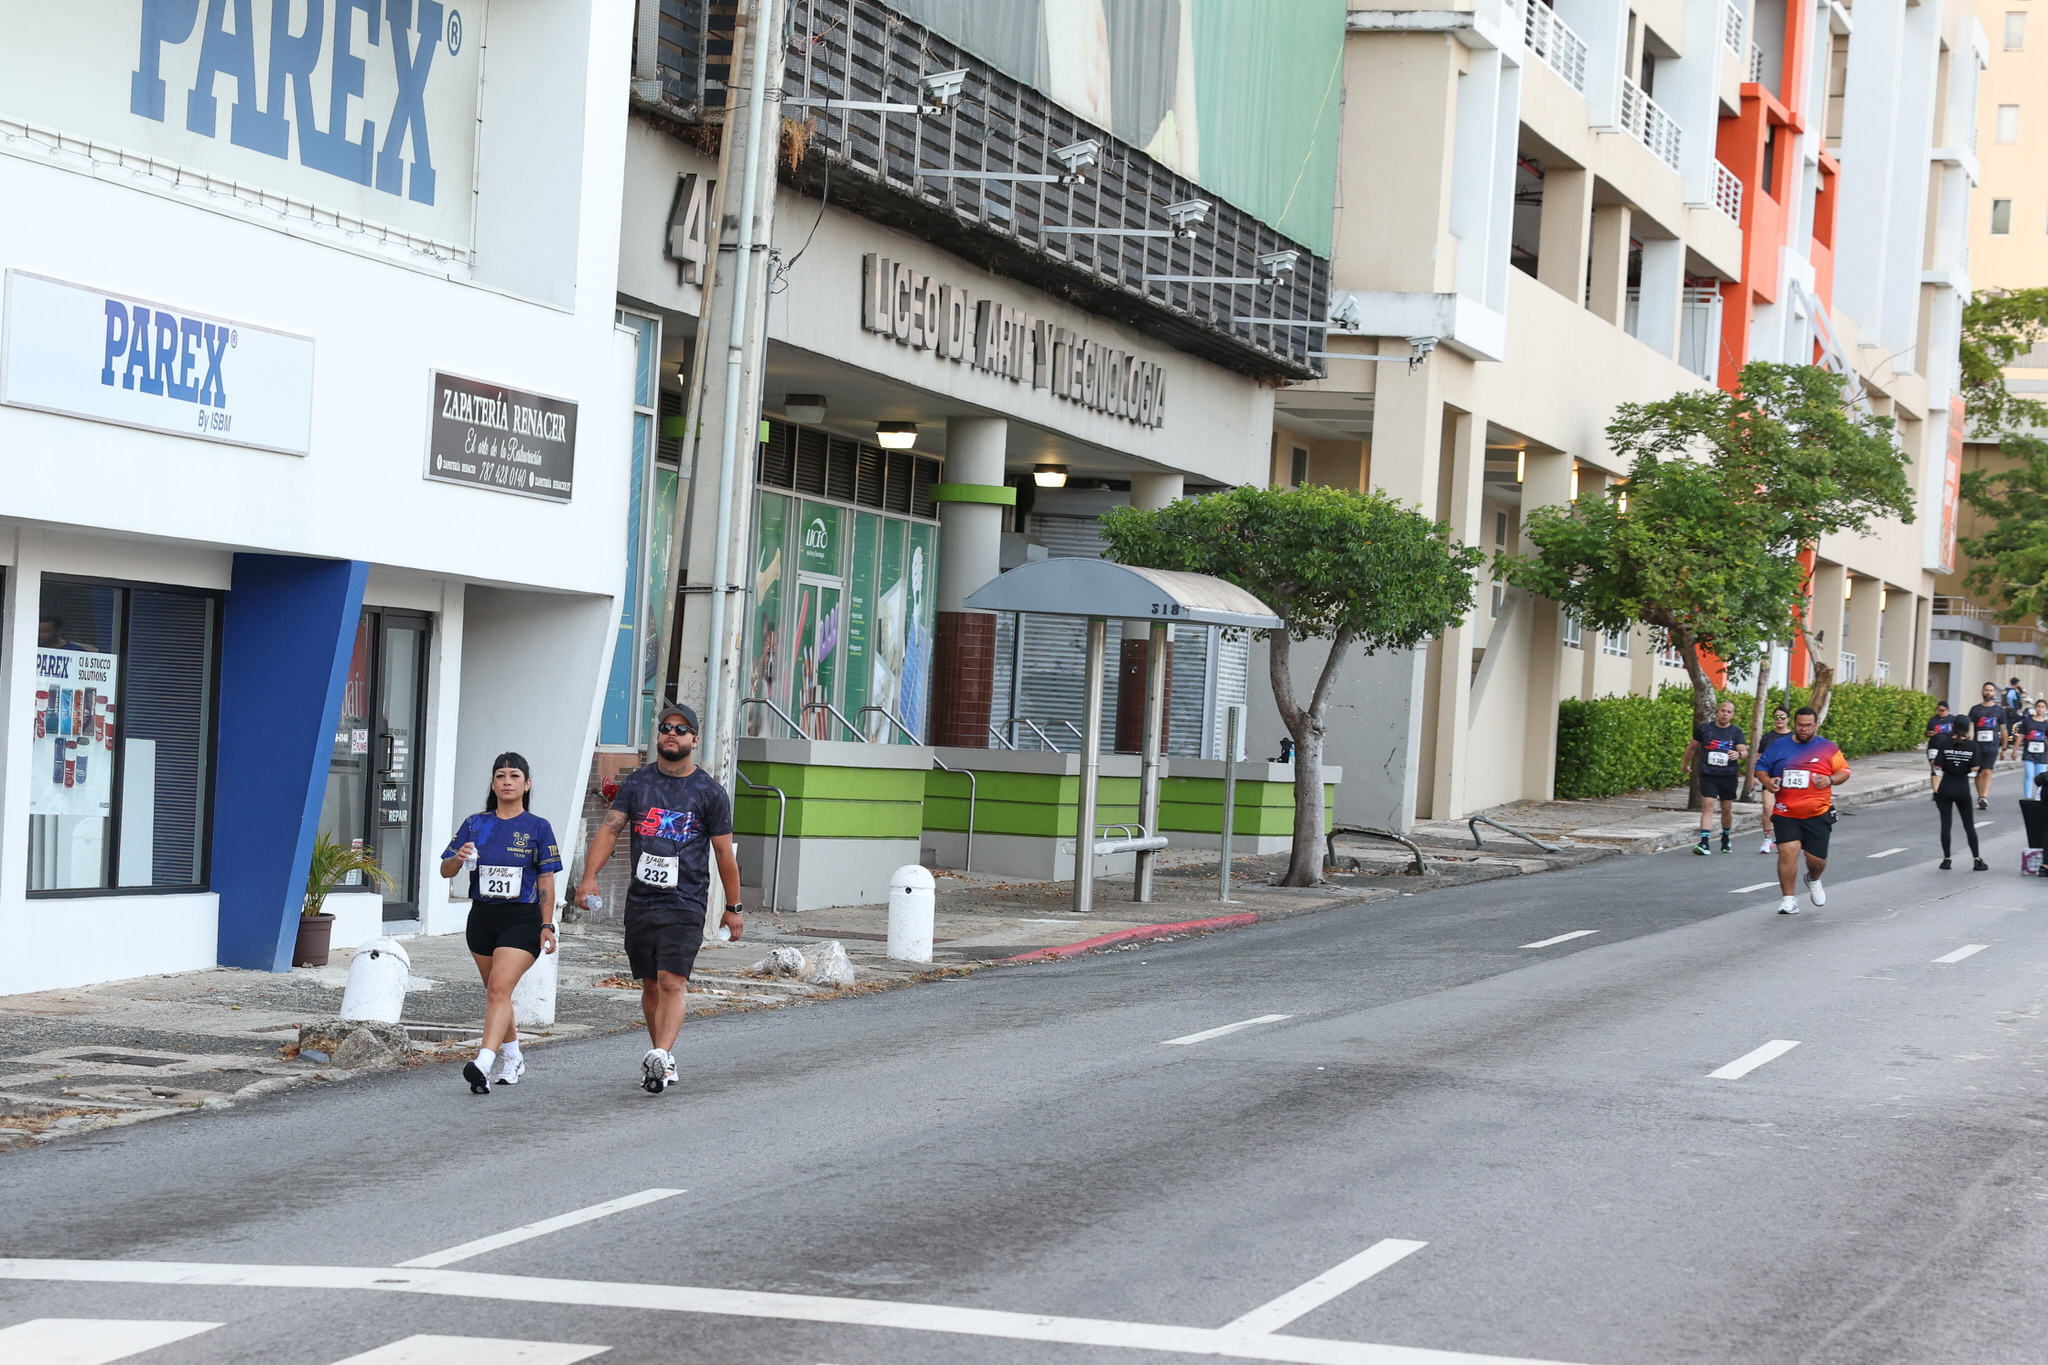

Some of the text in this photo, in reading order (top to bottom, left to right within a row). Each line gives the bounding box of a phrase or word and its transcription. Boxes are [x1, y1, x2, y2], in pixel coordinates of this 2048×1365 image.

[862, 253, 941, 351] LICEO
[940, 285, 977, 363] DE
[976, 301, 1036, 383] ARTE
[1034, 320, 1057, 389] Y
[101, 299, 229, 409] PAREX
[198, 410, 232, 432] By ISBM
[442, 389, 566, 443] ZAPATERÍA RENACER
[465, 427, 477, 453] El
[490, 438, 498, 457] de
[479, 462, 495, 482] 787
[495, 465, 509, 484] 428
[806, 529, 828, 549] LICEO
[37, 653, 70, 679] PAREX
[85, 657, 89, 667] &
[90, 658, 111, 669] STUCCO
[78, 670, 107, 682] SOLUTIONS
[1787, 778, 1803, 786] 145
[382, 789, 397, 801] SHOE
[388, 810, 408, 822] REPAIR
[641, 807, 684, 831] 5K
[655, 829, 664, 837] &
[649, 856, 665, 864] FADE
[491, 867, 509, 875] FADE
[644, 868, 668, 883] 232
[488, 880, 511, 893] 231
